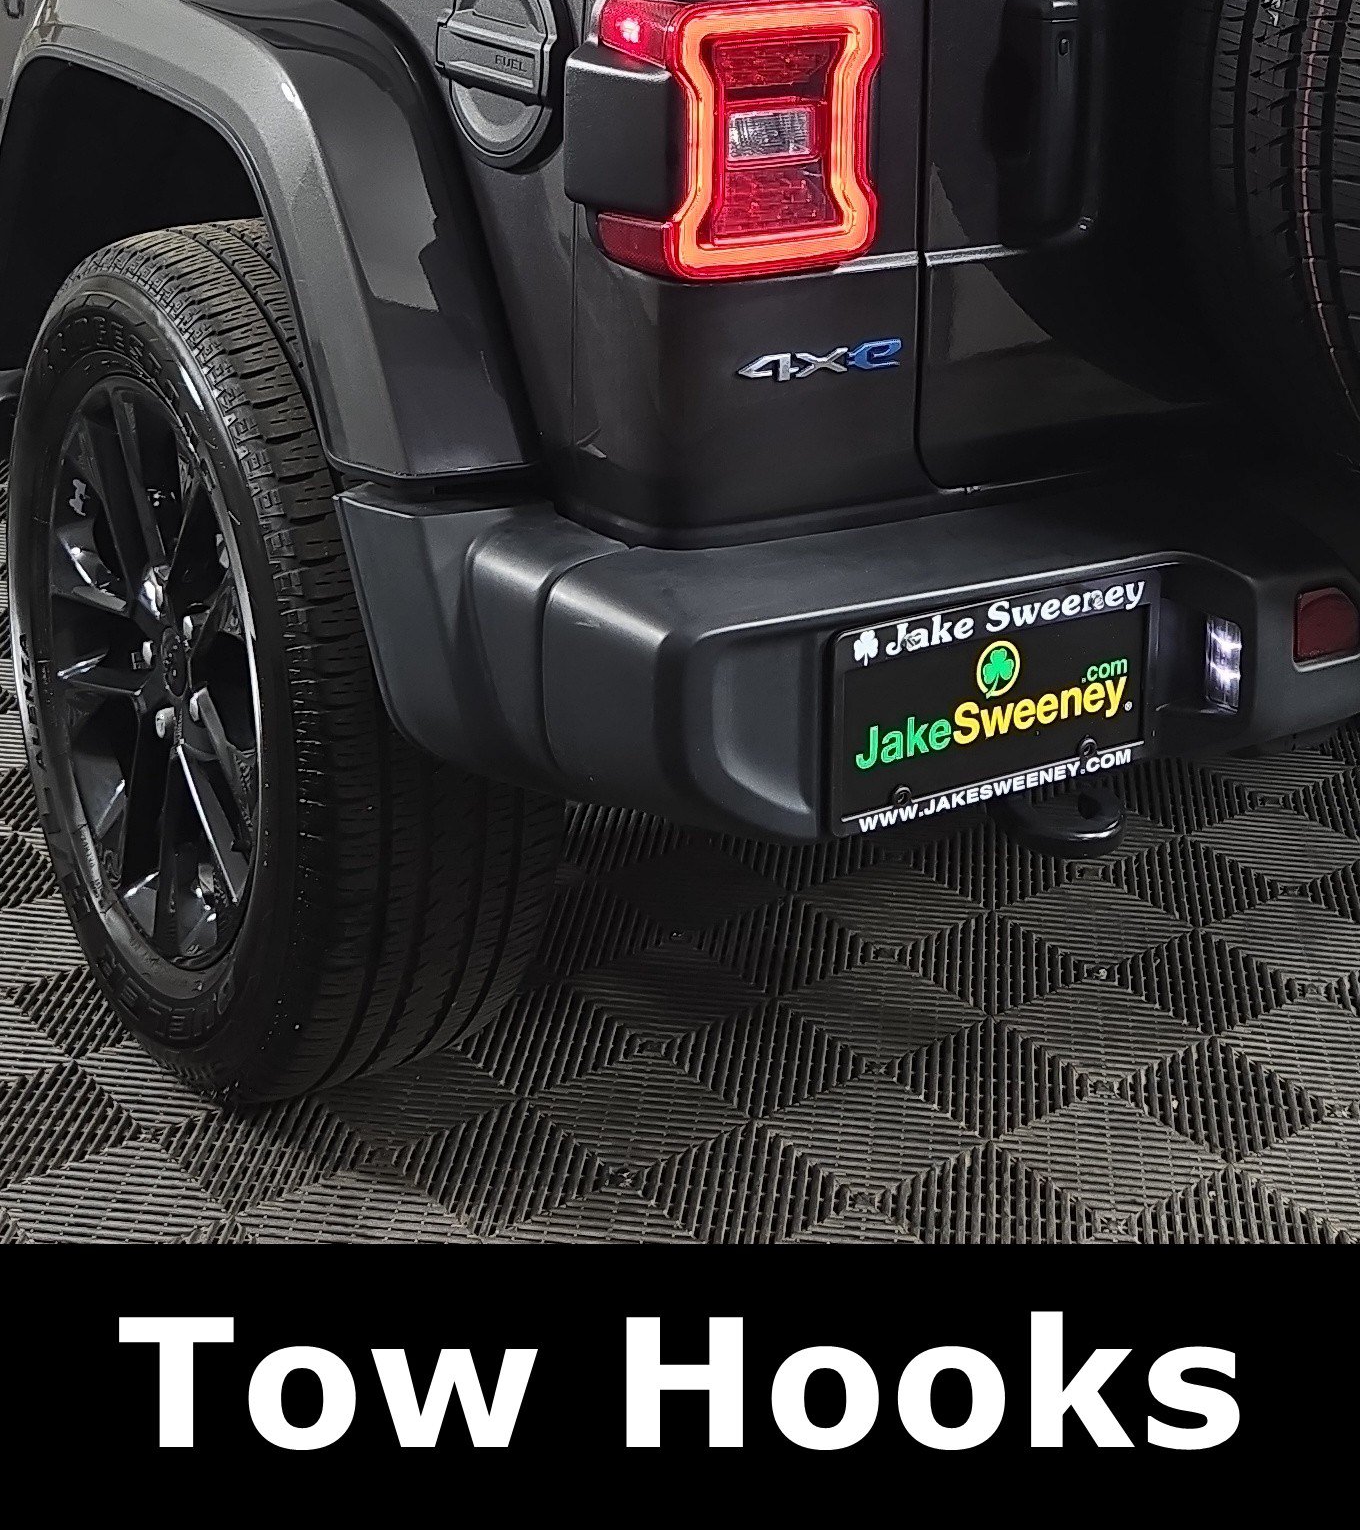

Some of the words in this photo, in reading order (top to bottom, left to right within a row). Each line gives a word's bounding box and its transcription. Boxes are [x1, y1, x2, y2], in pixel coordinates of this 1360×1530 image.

[494, 54, 528, 73] FUEL
[885, 614, 975, 657] Jake
[985, 579, 1146, 633] Sweeney
[858, 748, 1132, 833] WWW.JAKESWEENEY.COM
